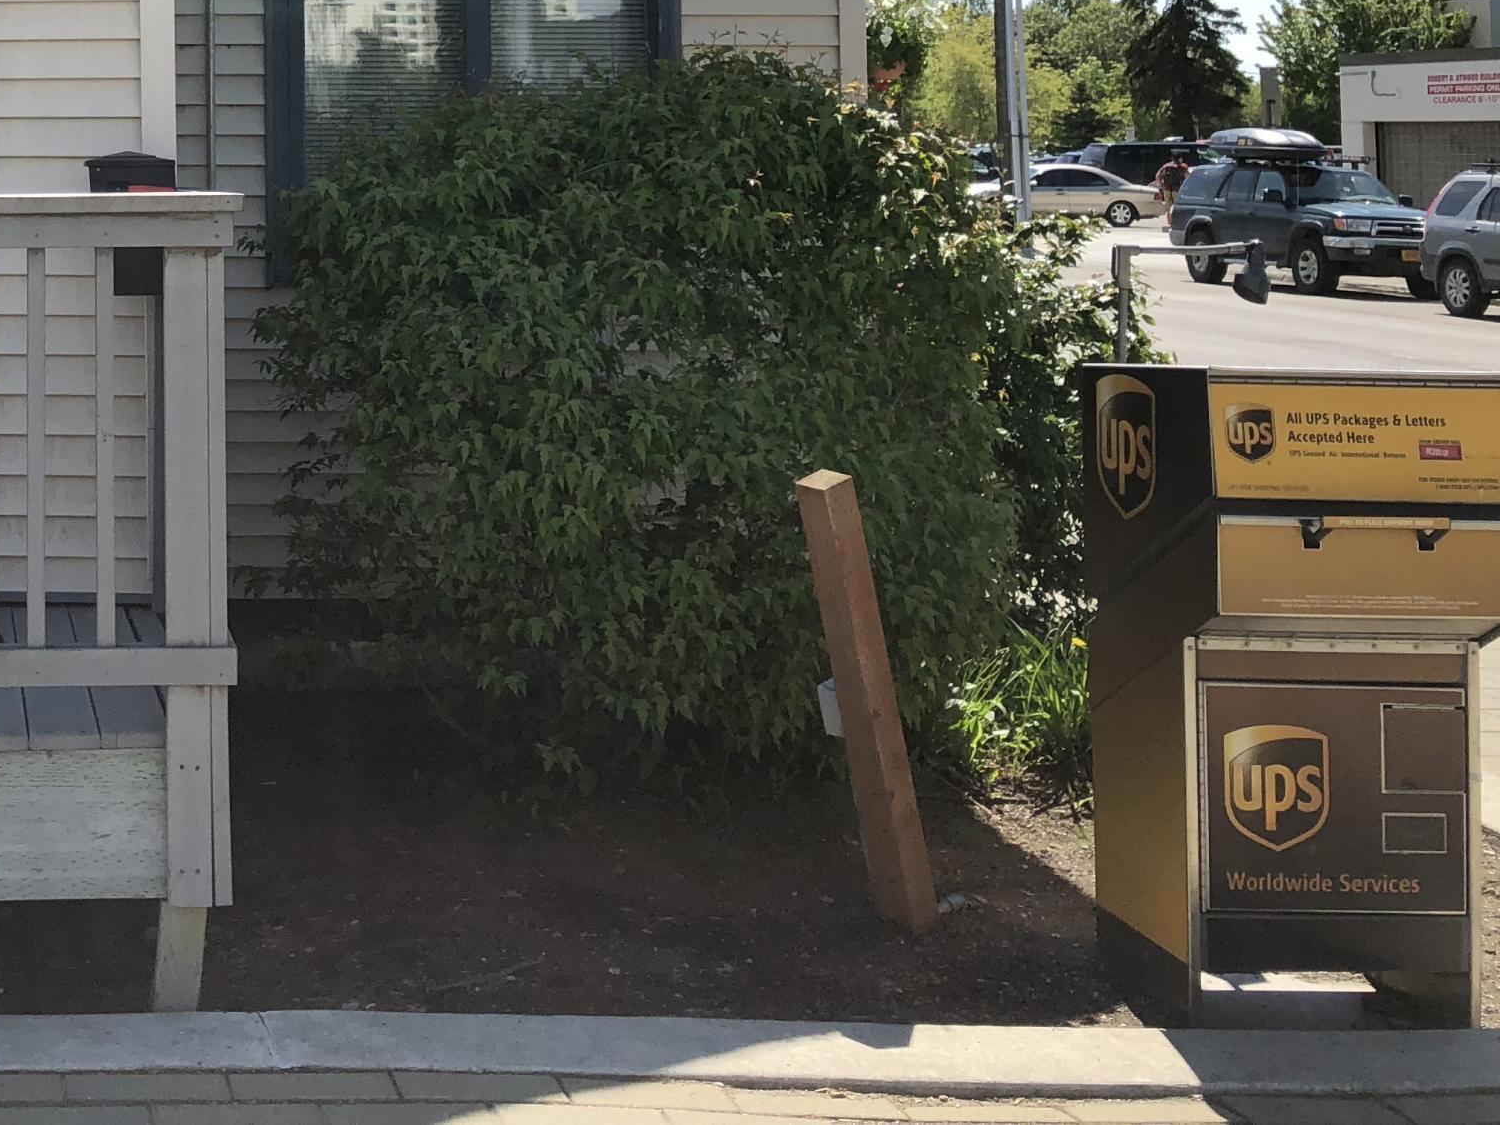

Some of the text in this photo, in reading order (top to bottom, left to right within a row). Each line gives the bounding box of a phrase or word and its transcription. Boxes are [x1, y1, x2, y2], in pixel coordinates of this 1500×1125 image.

[1429, 85, 1453, 93] PERMIT
[1455, 84, 1485, 92] PARKING
[1433, 96, 1476, 104] CLEARANCE
[1286, 412, 1446, 428] All UPS Packages & Letters
[1288, 431, 1375, 445] Accepted Here
[1226, 871, 1421, 894] Worldwide Services
